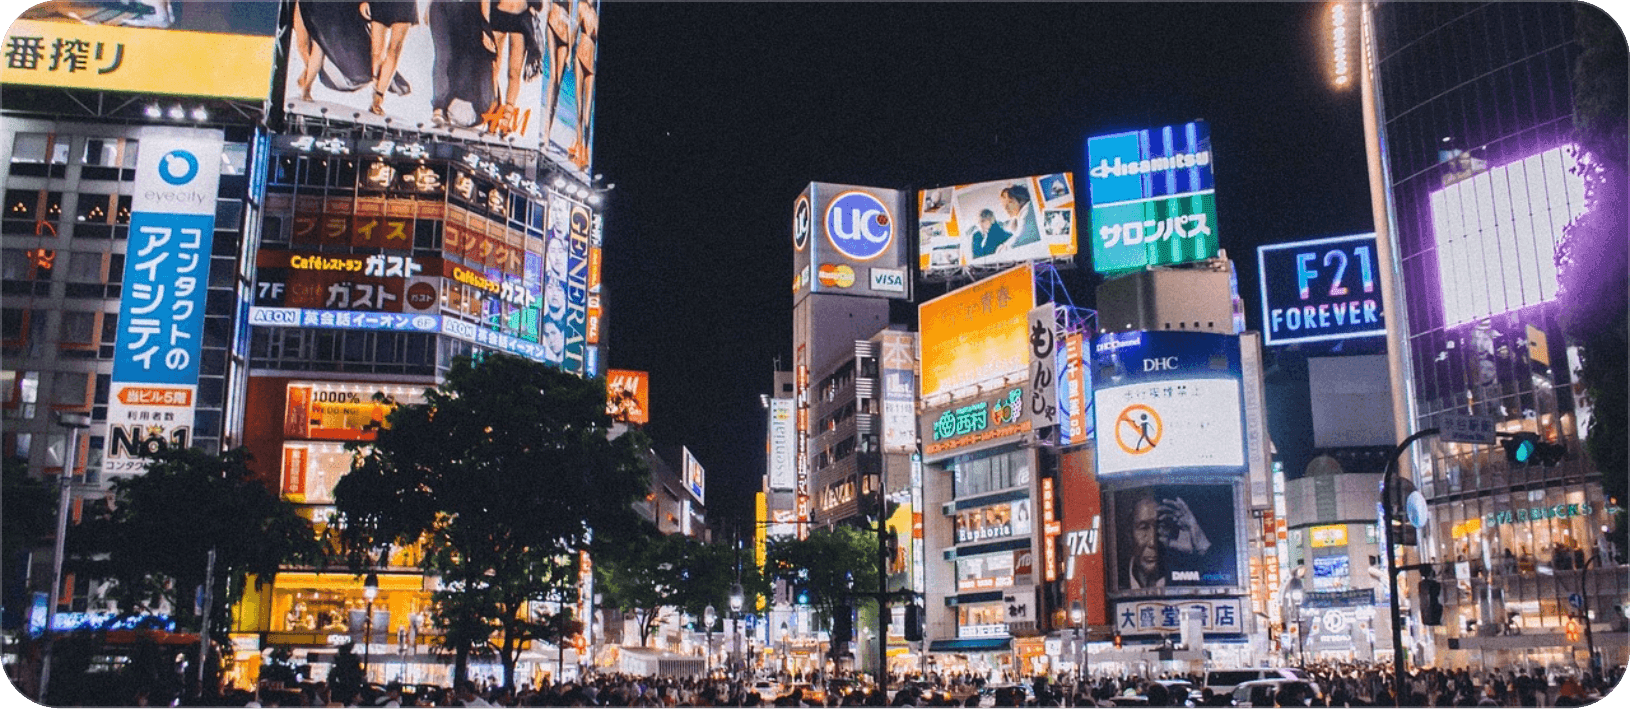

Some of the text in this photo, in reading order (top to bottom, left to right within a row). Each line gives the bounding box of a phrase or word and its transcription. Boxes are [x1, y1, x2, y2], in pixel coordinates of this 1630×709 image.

[5, 36, 124, 75] 番搾り
[1089, 150, 1209, 179] Hisamitsu
[144, 189, 206, 204] eyecity
[833, 207, 889, 243] UC
[1099, 213, 1211, 249] サロンパス
[364, 254, 422, 278] ガスト
[1296, 245, 1374, 300] F21
[258, 281, 285, 299] 7F
[875, 273, 903, 286] VISA
[127, 225, 173, 370] アイシティ
[165, 228, 202, 371] コンタクトの
[325, 281, 397, 310] ガスト
[410, 293, 433, 302] ガスト
[254, 309, 296, 323] AEON
[303, 310, 409, 327] 英会話イーオン
[1271, 299, 1378, 333] FOREVER
[1029, 318, 1057, 423] もんじゃ
[1142, 356, 1179, 372] DHC
[126, 389, 187, 405] 当ビル5階
[313, 391, 360, 404] 1000%
[127, 410, 175, 421] 利用者数
[1486, 503, 1592, 527] STARBUCKS
[959, 524, 1011, 543] Euphoria
